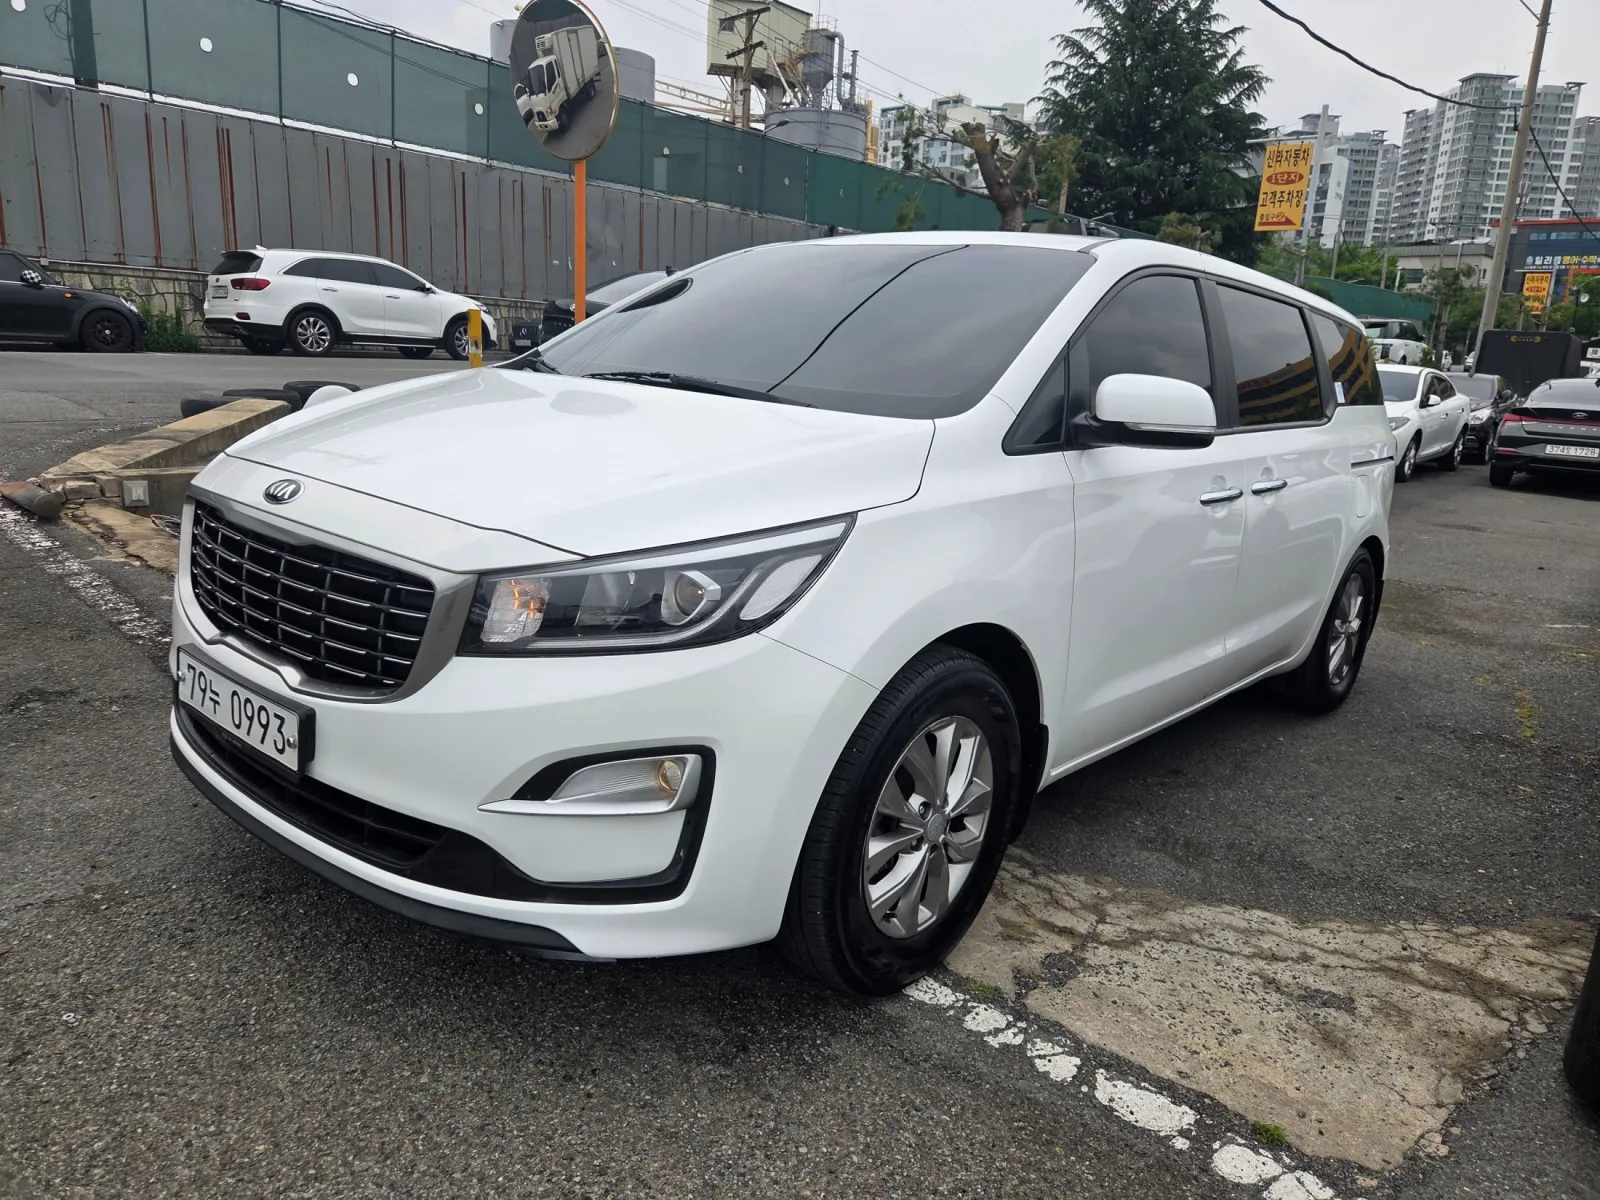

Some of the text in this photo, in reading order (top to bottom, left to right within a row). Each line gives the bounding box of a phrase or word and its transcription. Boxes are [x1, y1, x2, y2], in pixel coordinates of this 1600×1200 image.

[1260, 190, 1303, 208] 고객주차장
[1573, 447, 1596, 456] 1728
[187, 662, 286, 755] 79누 0993
